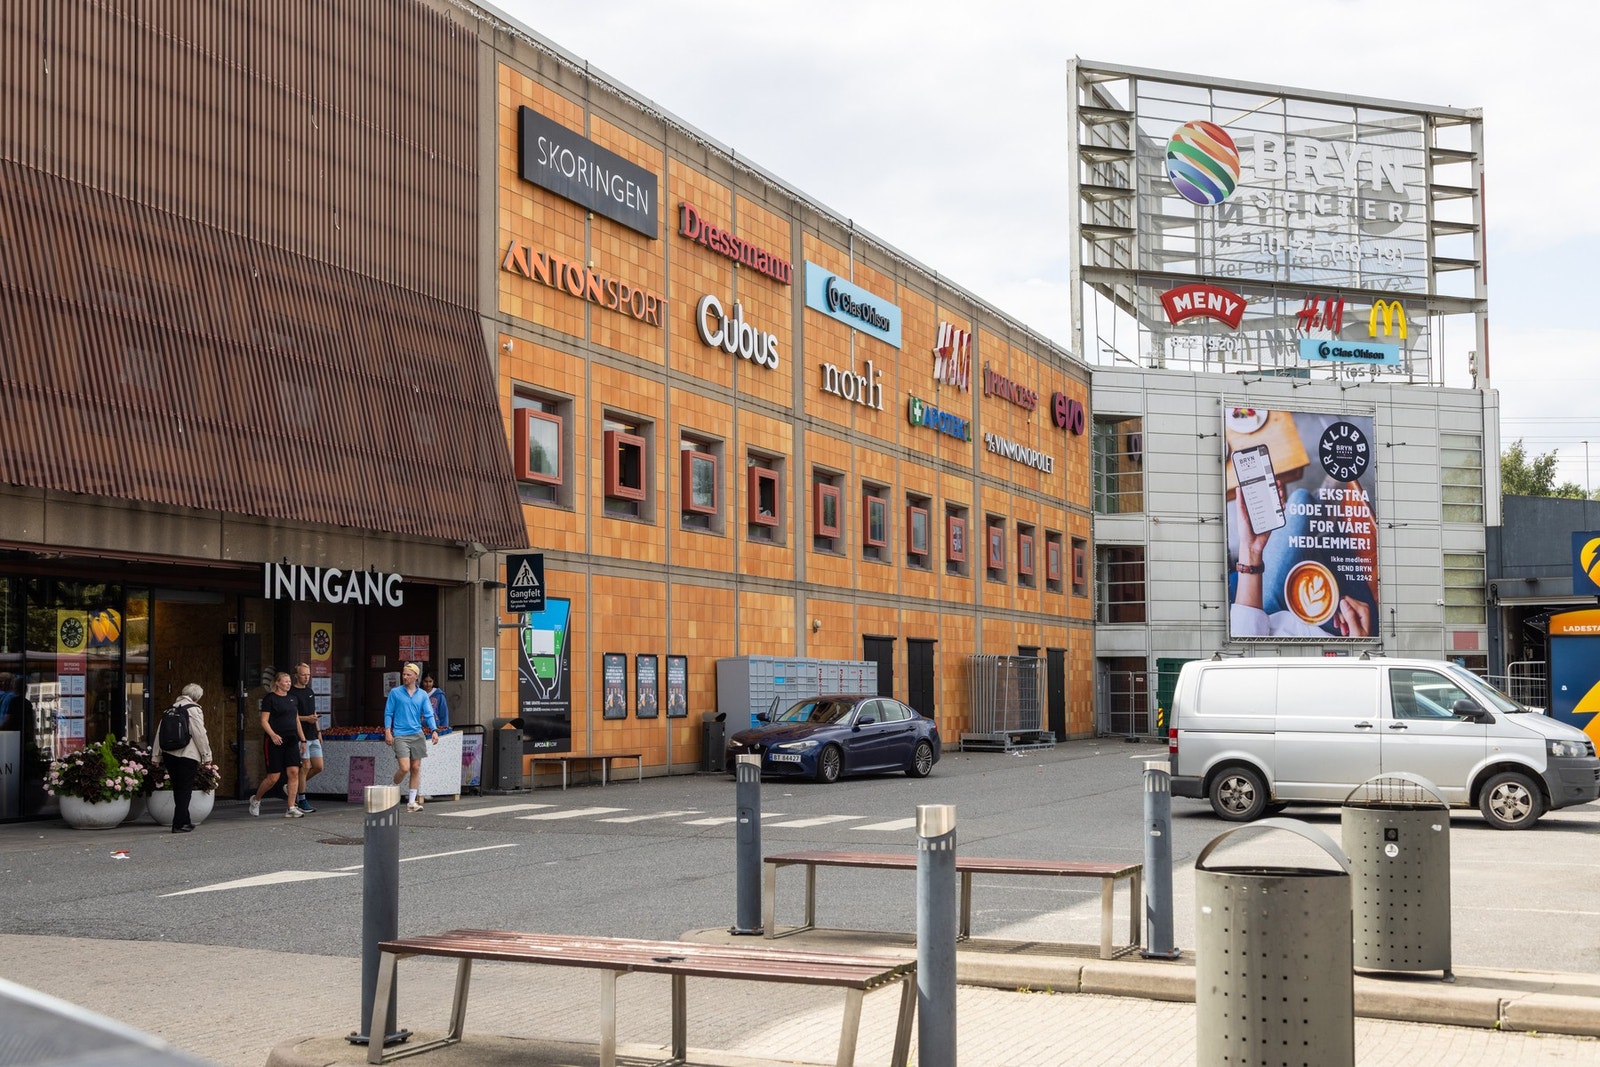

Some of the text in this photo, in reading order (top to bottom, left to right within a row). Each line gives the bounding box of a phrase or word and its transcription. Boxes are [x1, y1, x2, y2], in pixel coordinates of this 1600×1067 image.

[537, 136, 649, 215] SKORINGEN
[1254, 133, 1404, 193] BRYN
[1256, 190, 1404, 223] SENTER
[679, 201, 792, 286] Dressmann
[841, 292, 891, 333] Clas Ohlson
[1172, 291, 1239, 316] MENY
[1296, 293, 1345, 335] H&M
[697, 294, 779, 370] Cubus
[1332, 347, 1385, 360] Clas Ohlson
[820, 360, 884, 411] norli
[1052, 392, 1086, 436] evo
[995, 435, 1055, 475] VINMONOPOLET
[1289, 503, 1371, 519] GODE TILBUD
[1319, 488, 1370, 502] EKSTRA
[1288, 535, 1371, 550] MEDLEMMER!
[1309, 518, 1371, 534] FOR VÅRE
[1344, 556, 1372, 564] medlem:
[264, 562, 404, 607] INNGANG
[509, 588, 542, 600] Gangfelt
